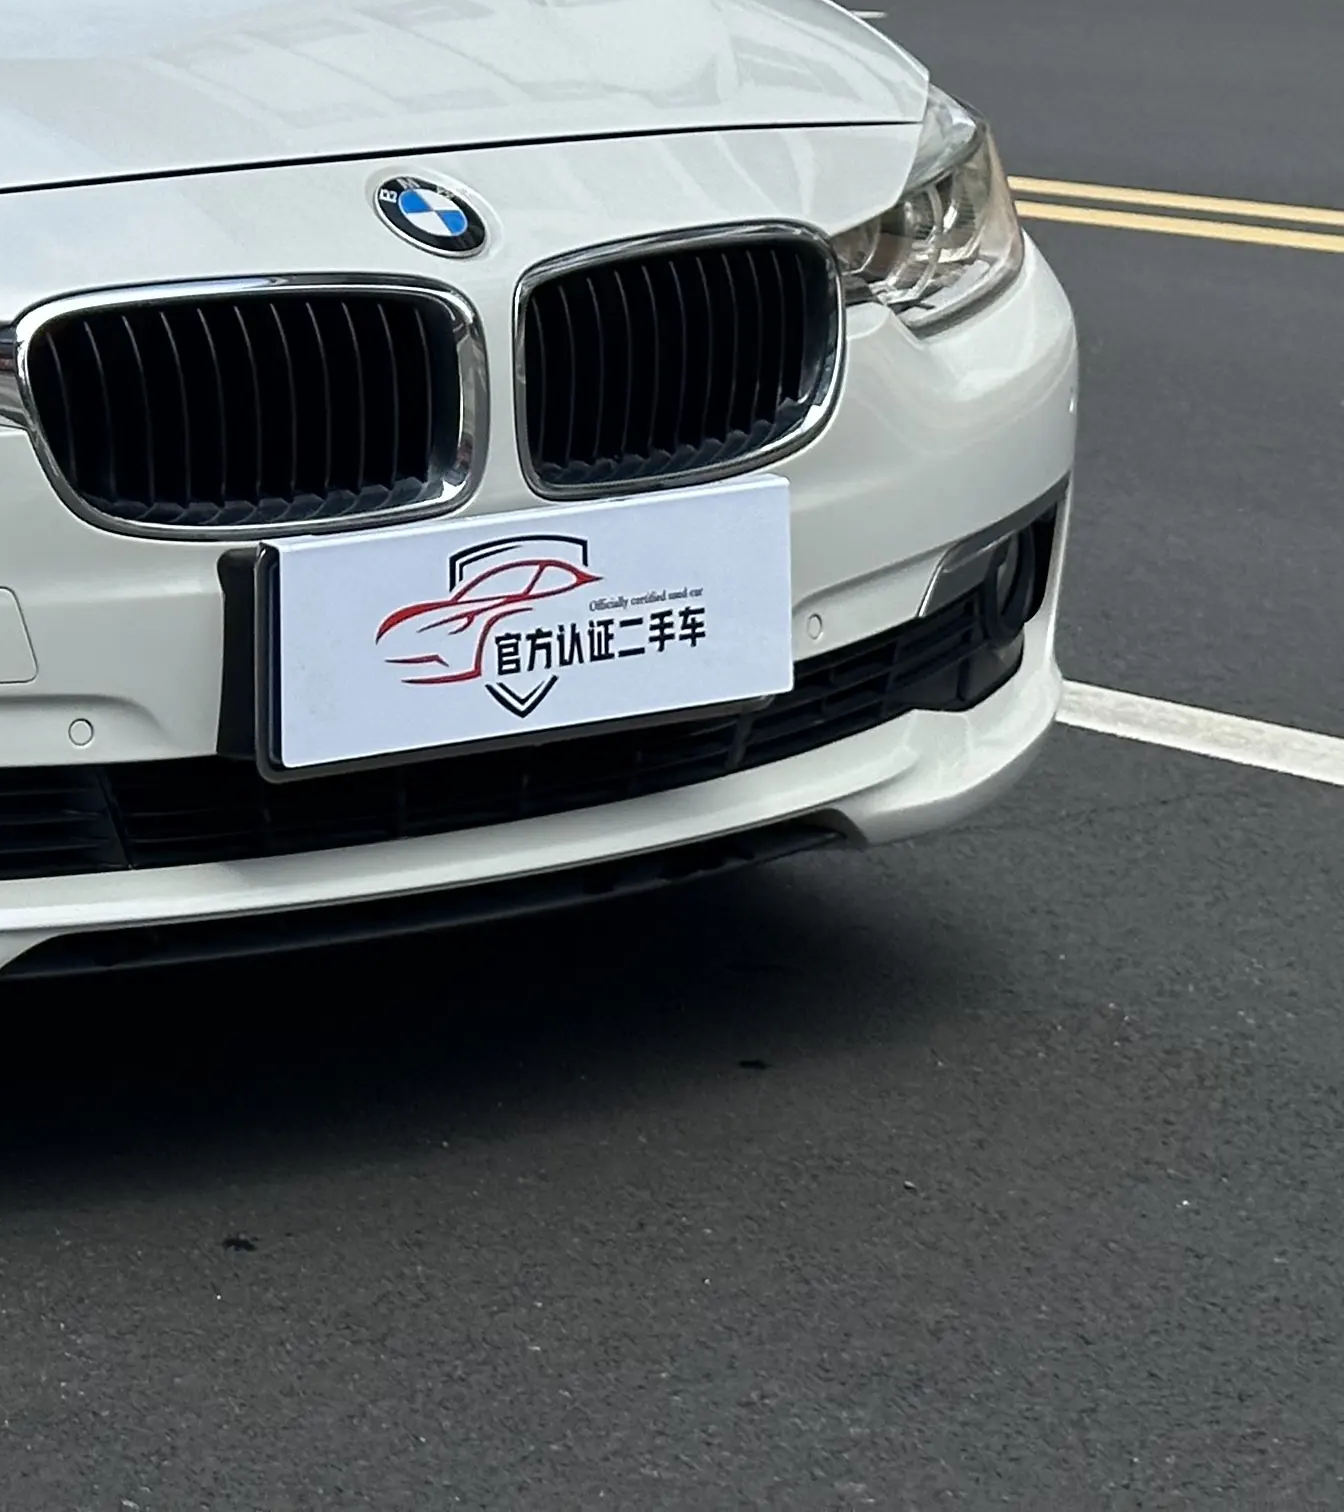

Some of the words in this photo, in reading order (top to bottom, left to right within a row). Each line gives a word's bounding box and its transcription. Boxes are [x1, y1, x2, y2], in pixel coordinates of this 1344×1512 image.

[589, 595, 629, 612] Officially
[630, 589, 667, 606] certified
[668, 587, 688, 600] used
[689, 587, 704, 597] car
[495, 606, 706, 676] 官方认证二手车
